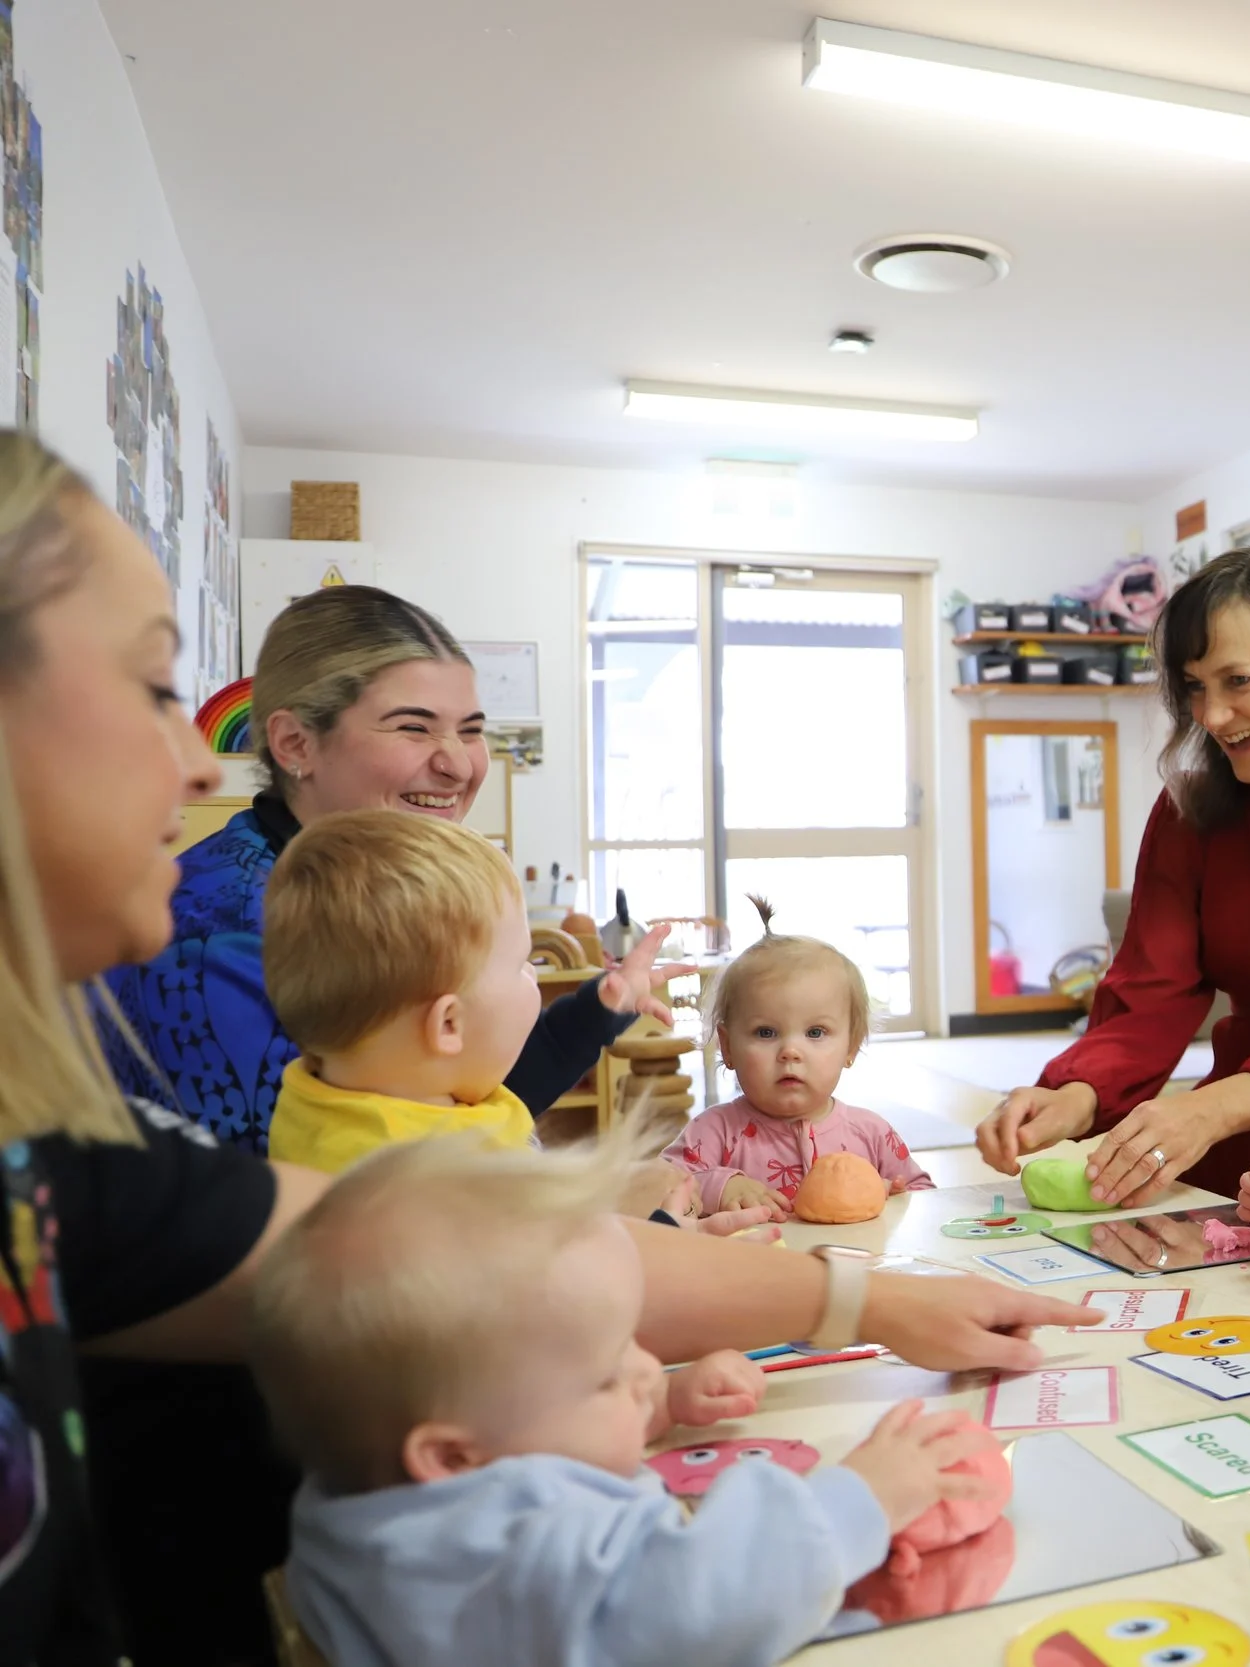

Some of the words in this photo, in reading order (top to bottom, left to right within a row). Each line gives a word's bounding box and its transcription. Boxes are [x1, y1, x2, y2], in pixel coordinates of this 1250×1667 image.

[1030, 1257, 1063, 1270] Sad
[1110, 1290, 1147, 1329] Surprised
[1036, 1371, 1068, 1424] Confused
